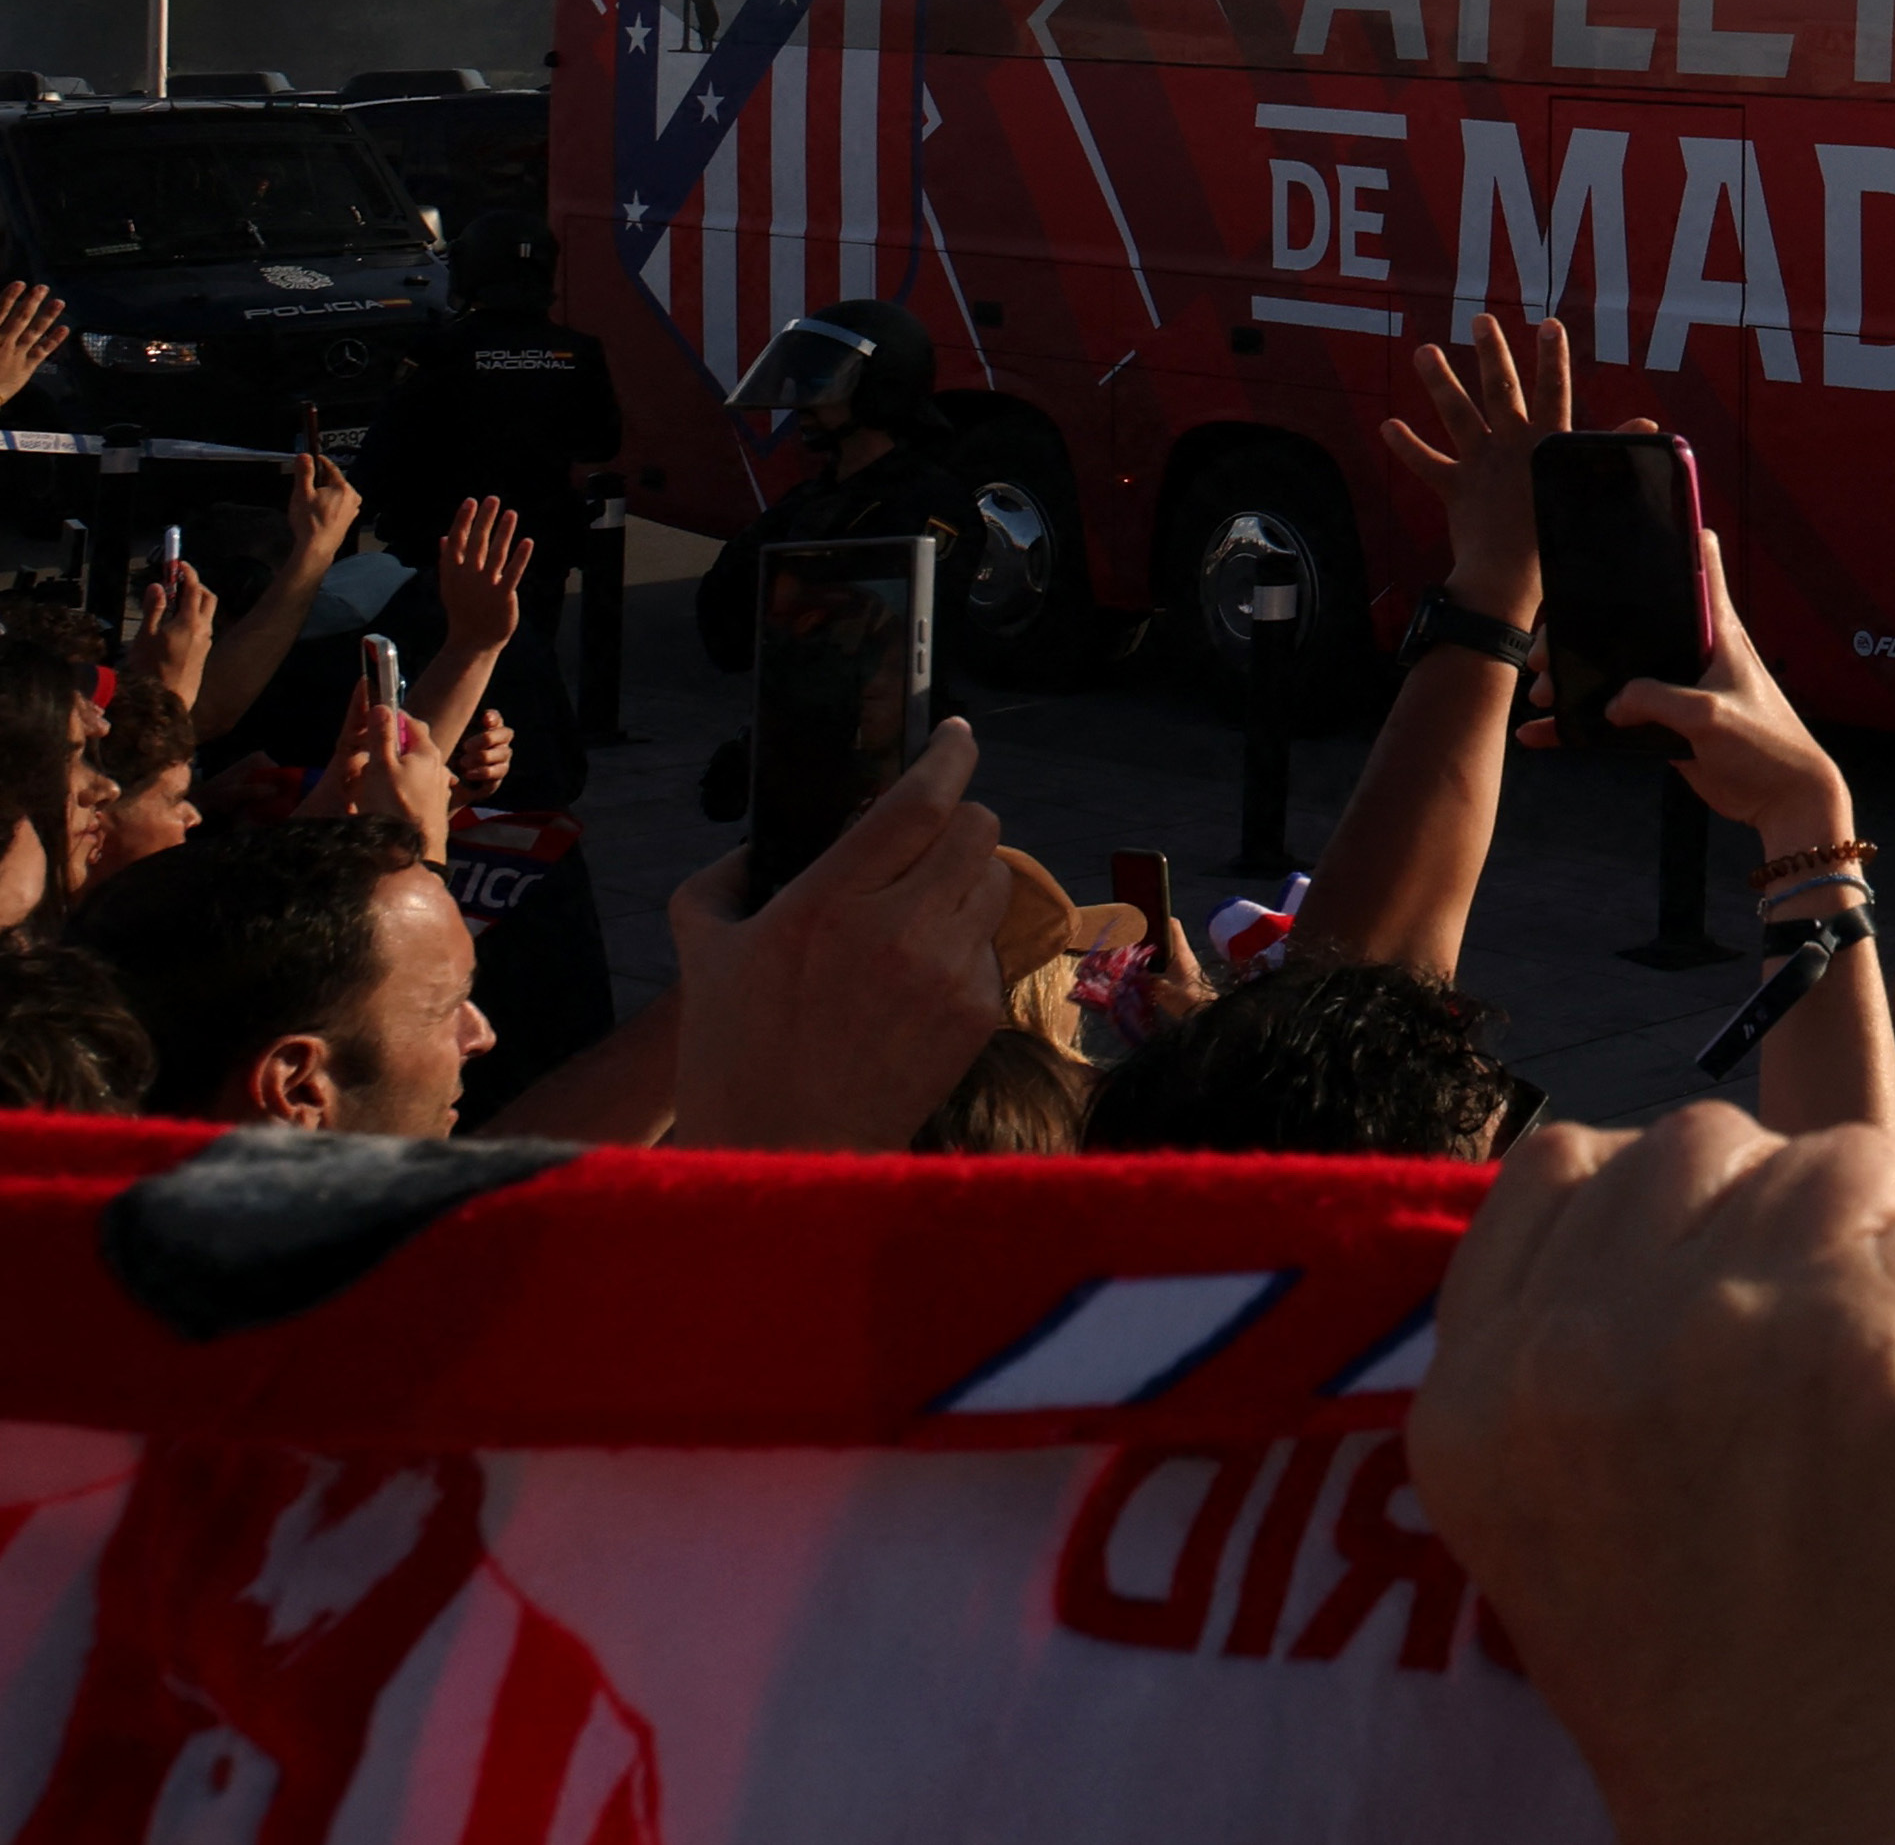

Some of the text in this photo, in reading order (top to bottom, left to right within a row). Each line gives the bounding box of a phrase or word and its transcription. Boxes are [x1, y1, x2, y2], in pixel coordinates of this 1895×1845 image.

[1269, 158, 1390, 281] DE
[243, 299, 385, 320] POLICIA
[475, 349, 554, 360] POLICIA
[475, 359, 576, 370] NACIONAL
